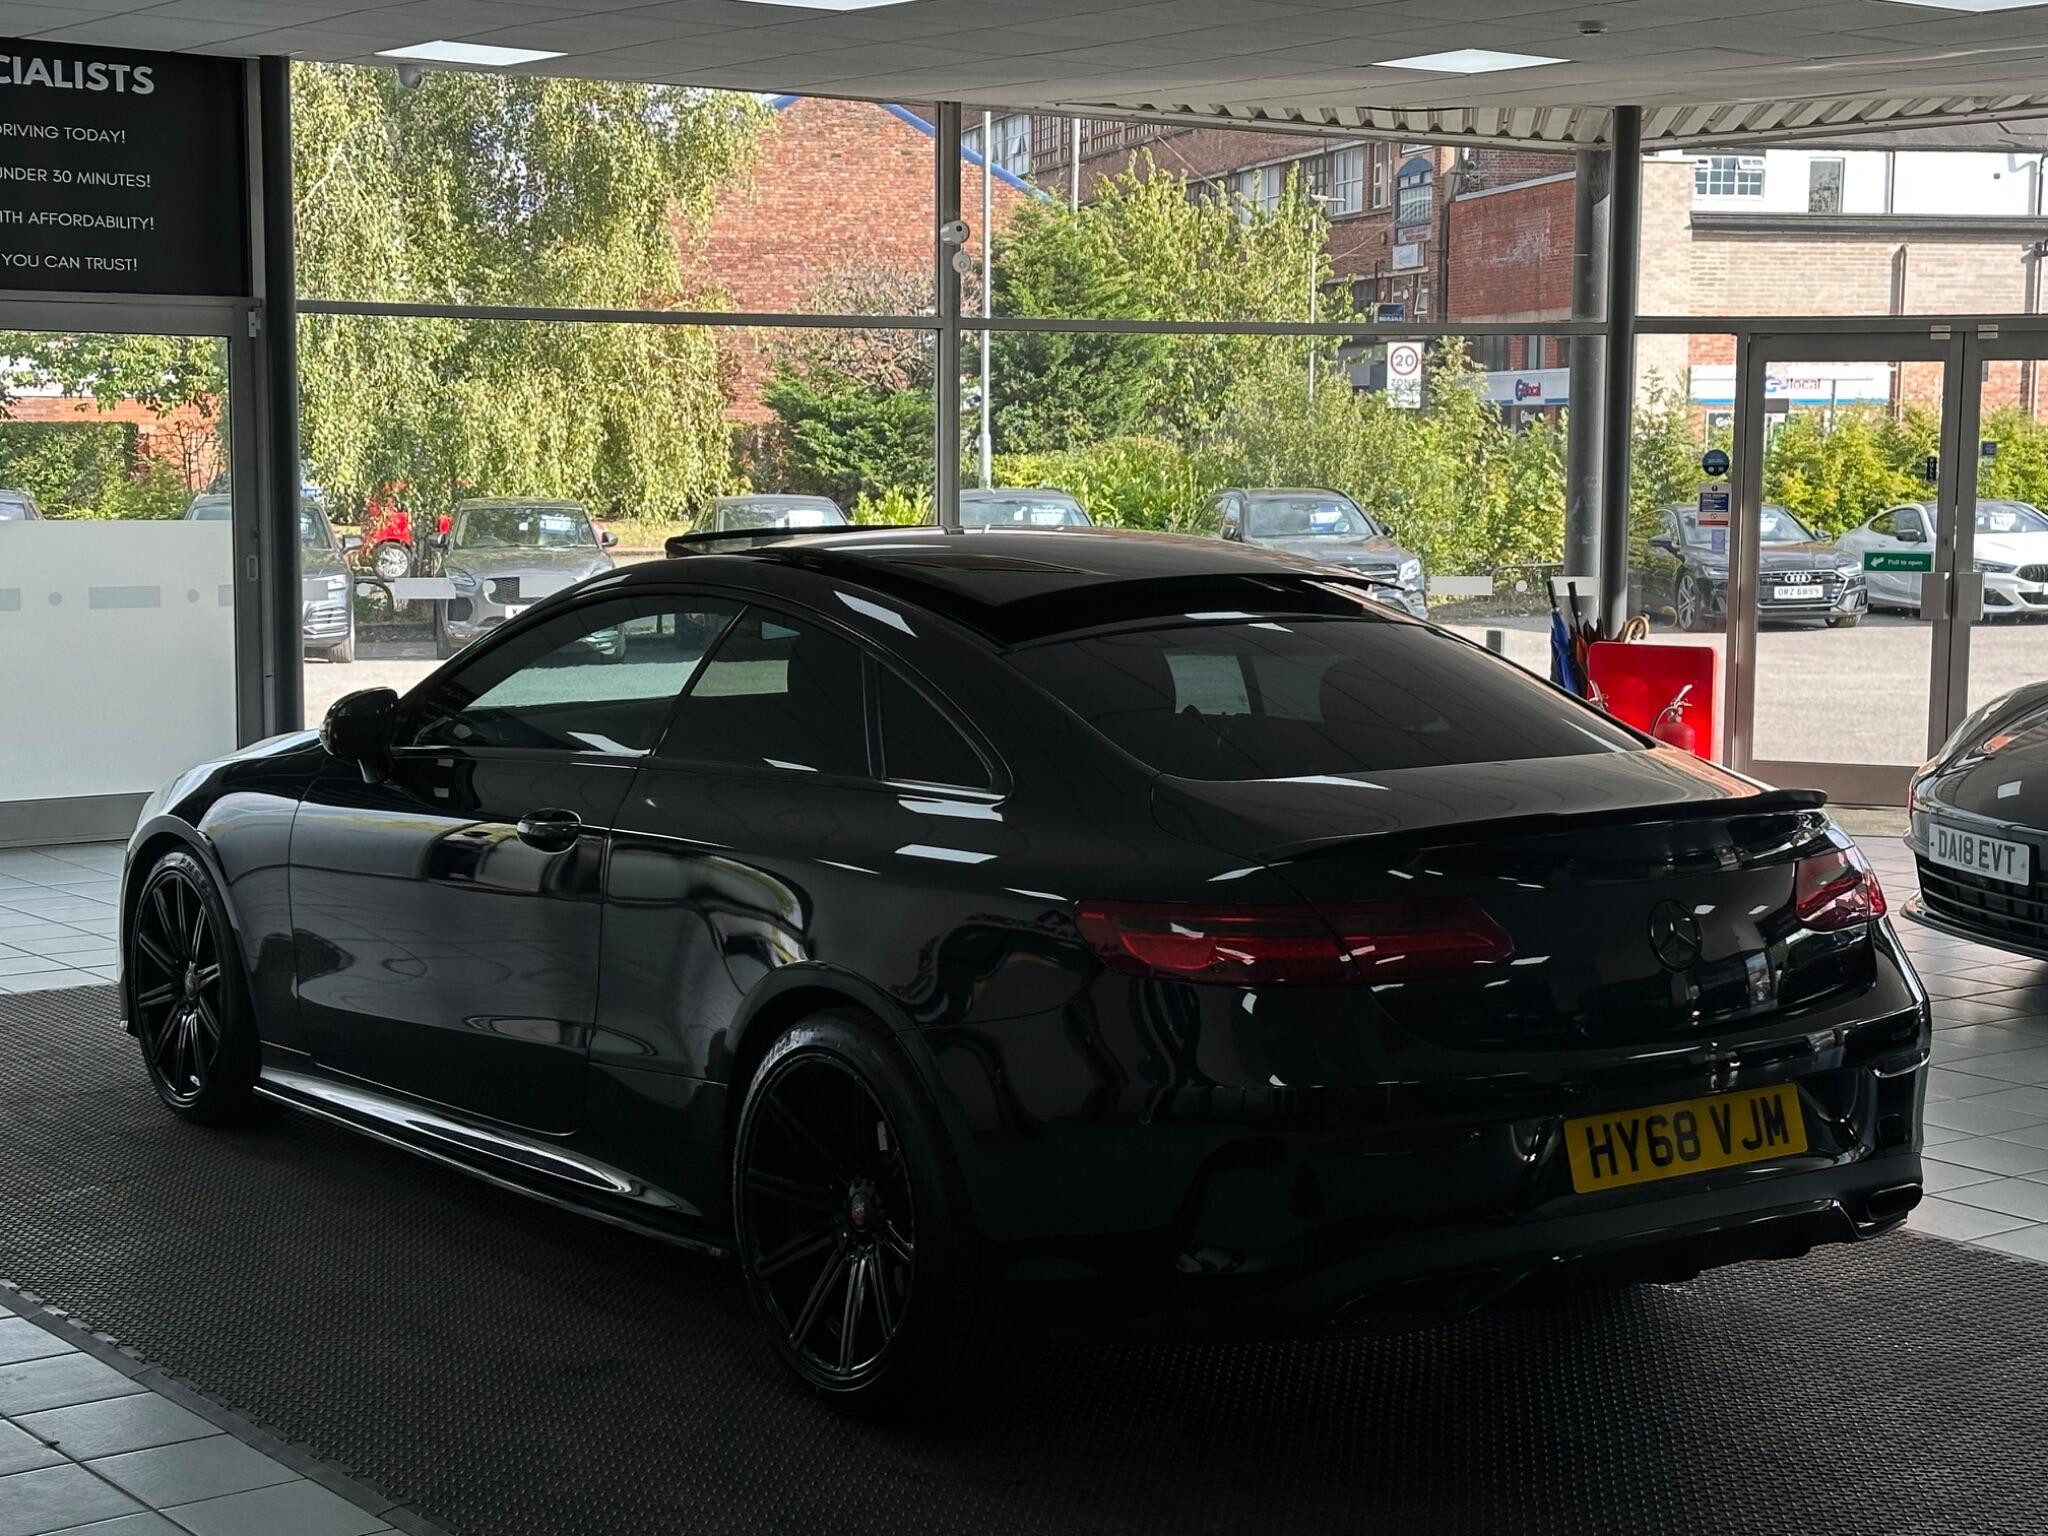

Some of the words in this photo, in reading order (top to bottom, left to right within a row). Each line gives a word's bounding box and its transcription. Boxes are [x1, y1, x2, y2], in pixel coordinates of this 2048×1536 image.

[0, 123, 59, 139] RIVING
[63, 127, 126, 144] TODAY!
[0, 166, 48, 182] NDER
[52, 169, 72, 183] 30
[76, 171, 152, 188] MINUTES!
[28, 211, 155, 231] AFFORDABILITY!
[1, 253, 40, 268] YOU
[44, 255, 80, 269] CAN
[84, 257, 138, 272] TRUST!
[1394, 354, 1415, 367] 20
[1937, 829, 1974, 865] DA18
[1978, 839, 2016, 875] EVT
[1585, 1109, 1703, 1179] HY68
[1708, 1093, 1790, 1156] VJM
